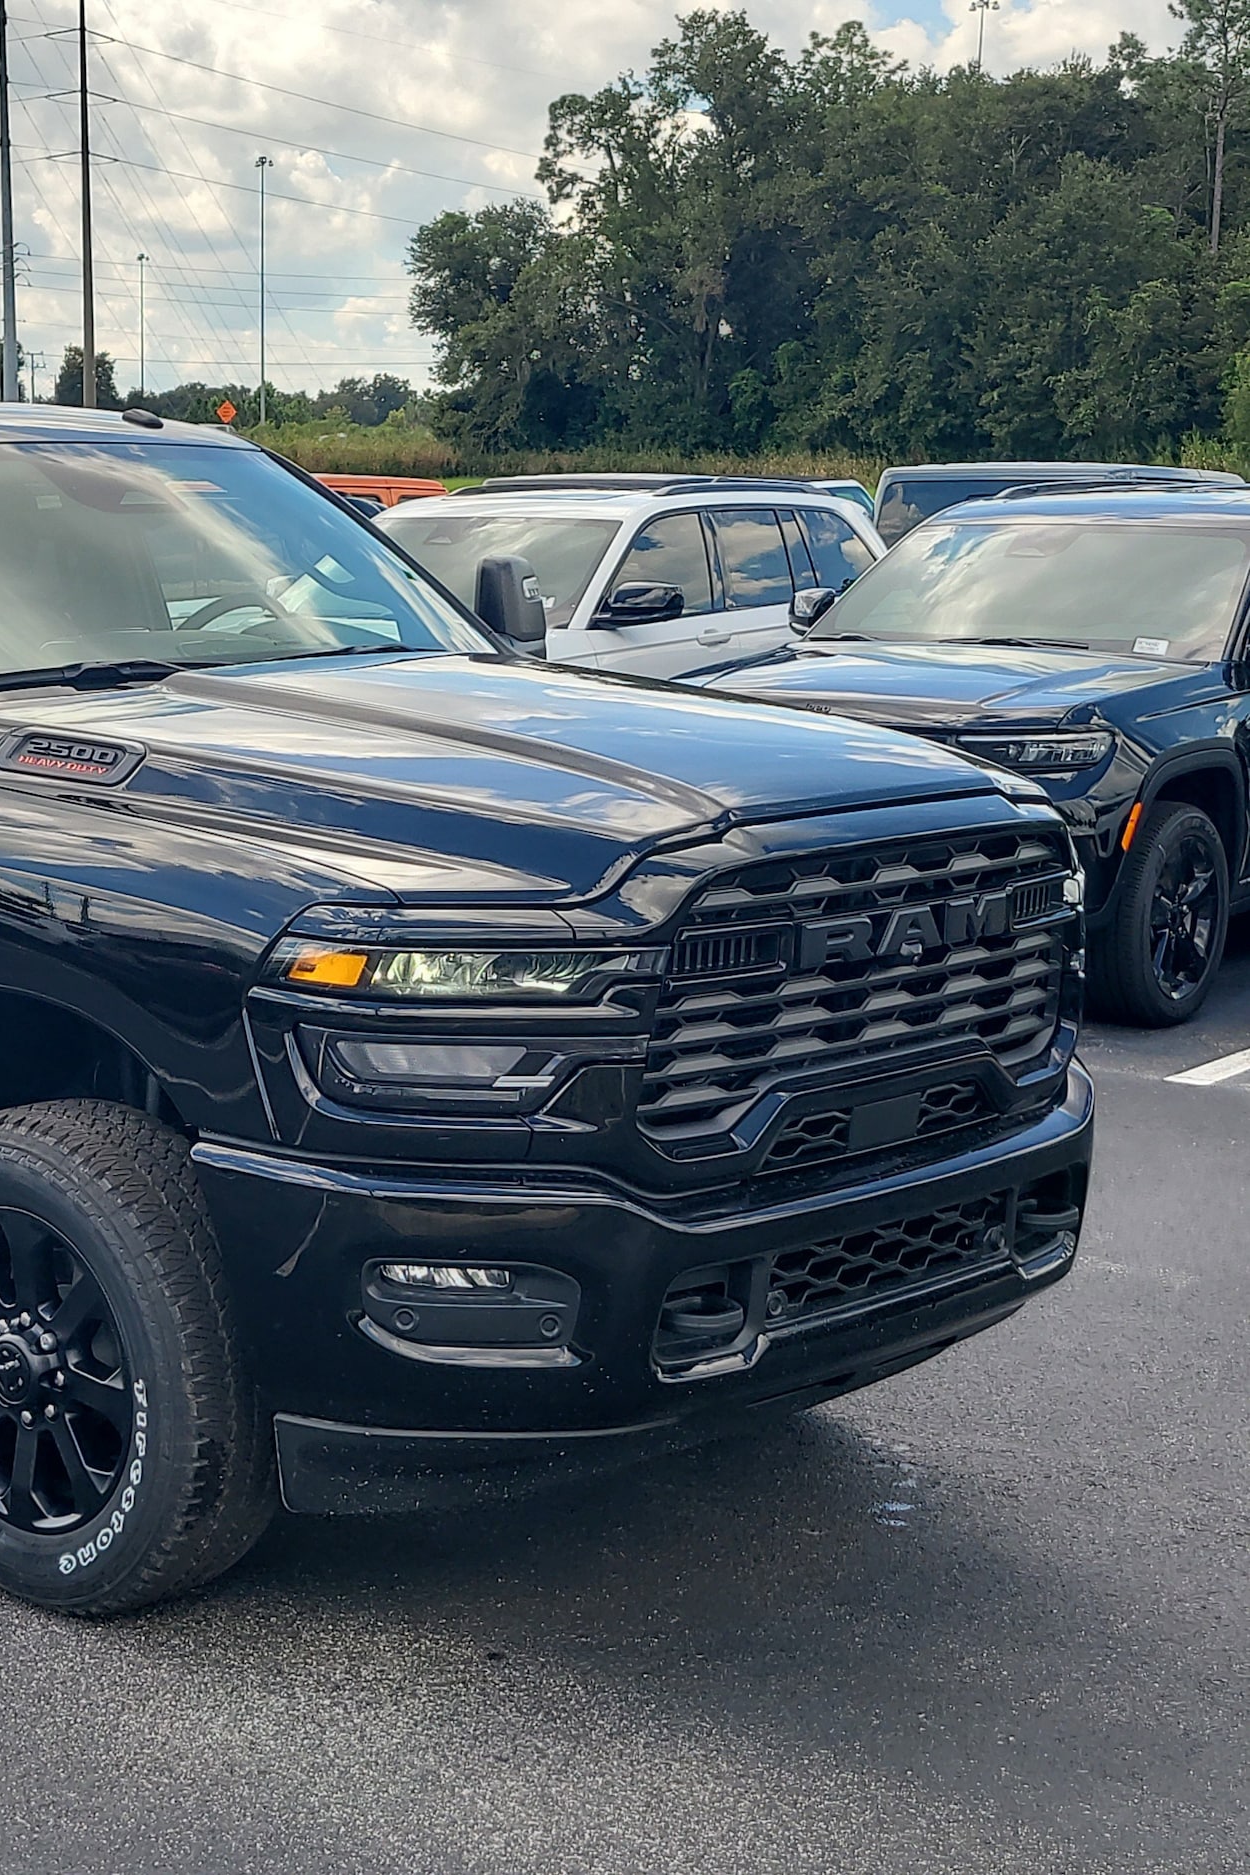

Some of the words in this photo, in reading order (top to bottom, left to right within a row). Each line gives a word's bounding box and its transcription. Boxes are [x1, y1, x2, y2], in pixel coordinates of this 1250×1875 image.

[18, 755, 66, 769] HEAVY
[66, 762, 108, 775] DUTY
[28, 739, 117, 764] 2500
[800, 890, 1008, 969] RAM
[58, 1378, 148, 1575] Firestone
